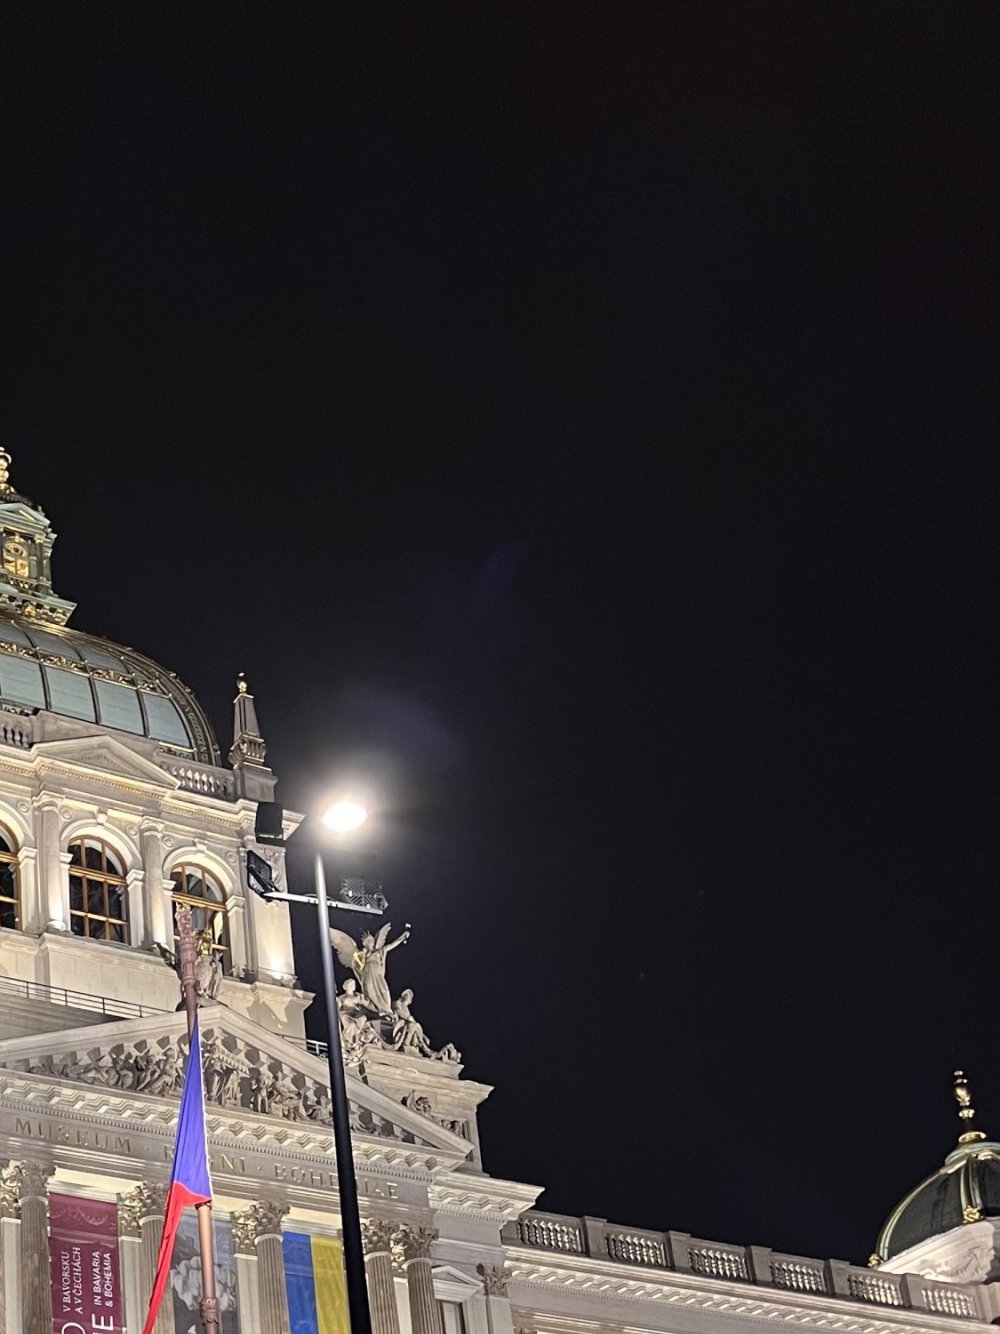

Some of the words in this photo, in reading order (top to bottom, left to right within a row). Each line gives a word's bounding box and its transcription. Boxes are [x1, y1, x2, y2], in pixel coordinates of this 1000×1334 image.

[15, 1118, 131, 1153] MUSEUM
[61, 1251, 71, 1303] BAVORSKU
[71, 1247, 82, 1295] ČECHÁCH
[91, 1251, 101, 1293] BAVARIA
[103, 1253, 113, 1297] BOHEMIA
[74, 1306, 83, 1314] A
[94, 1296, 102, 1306] IN
